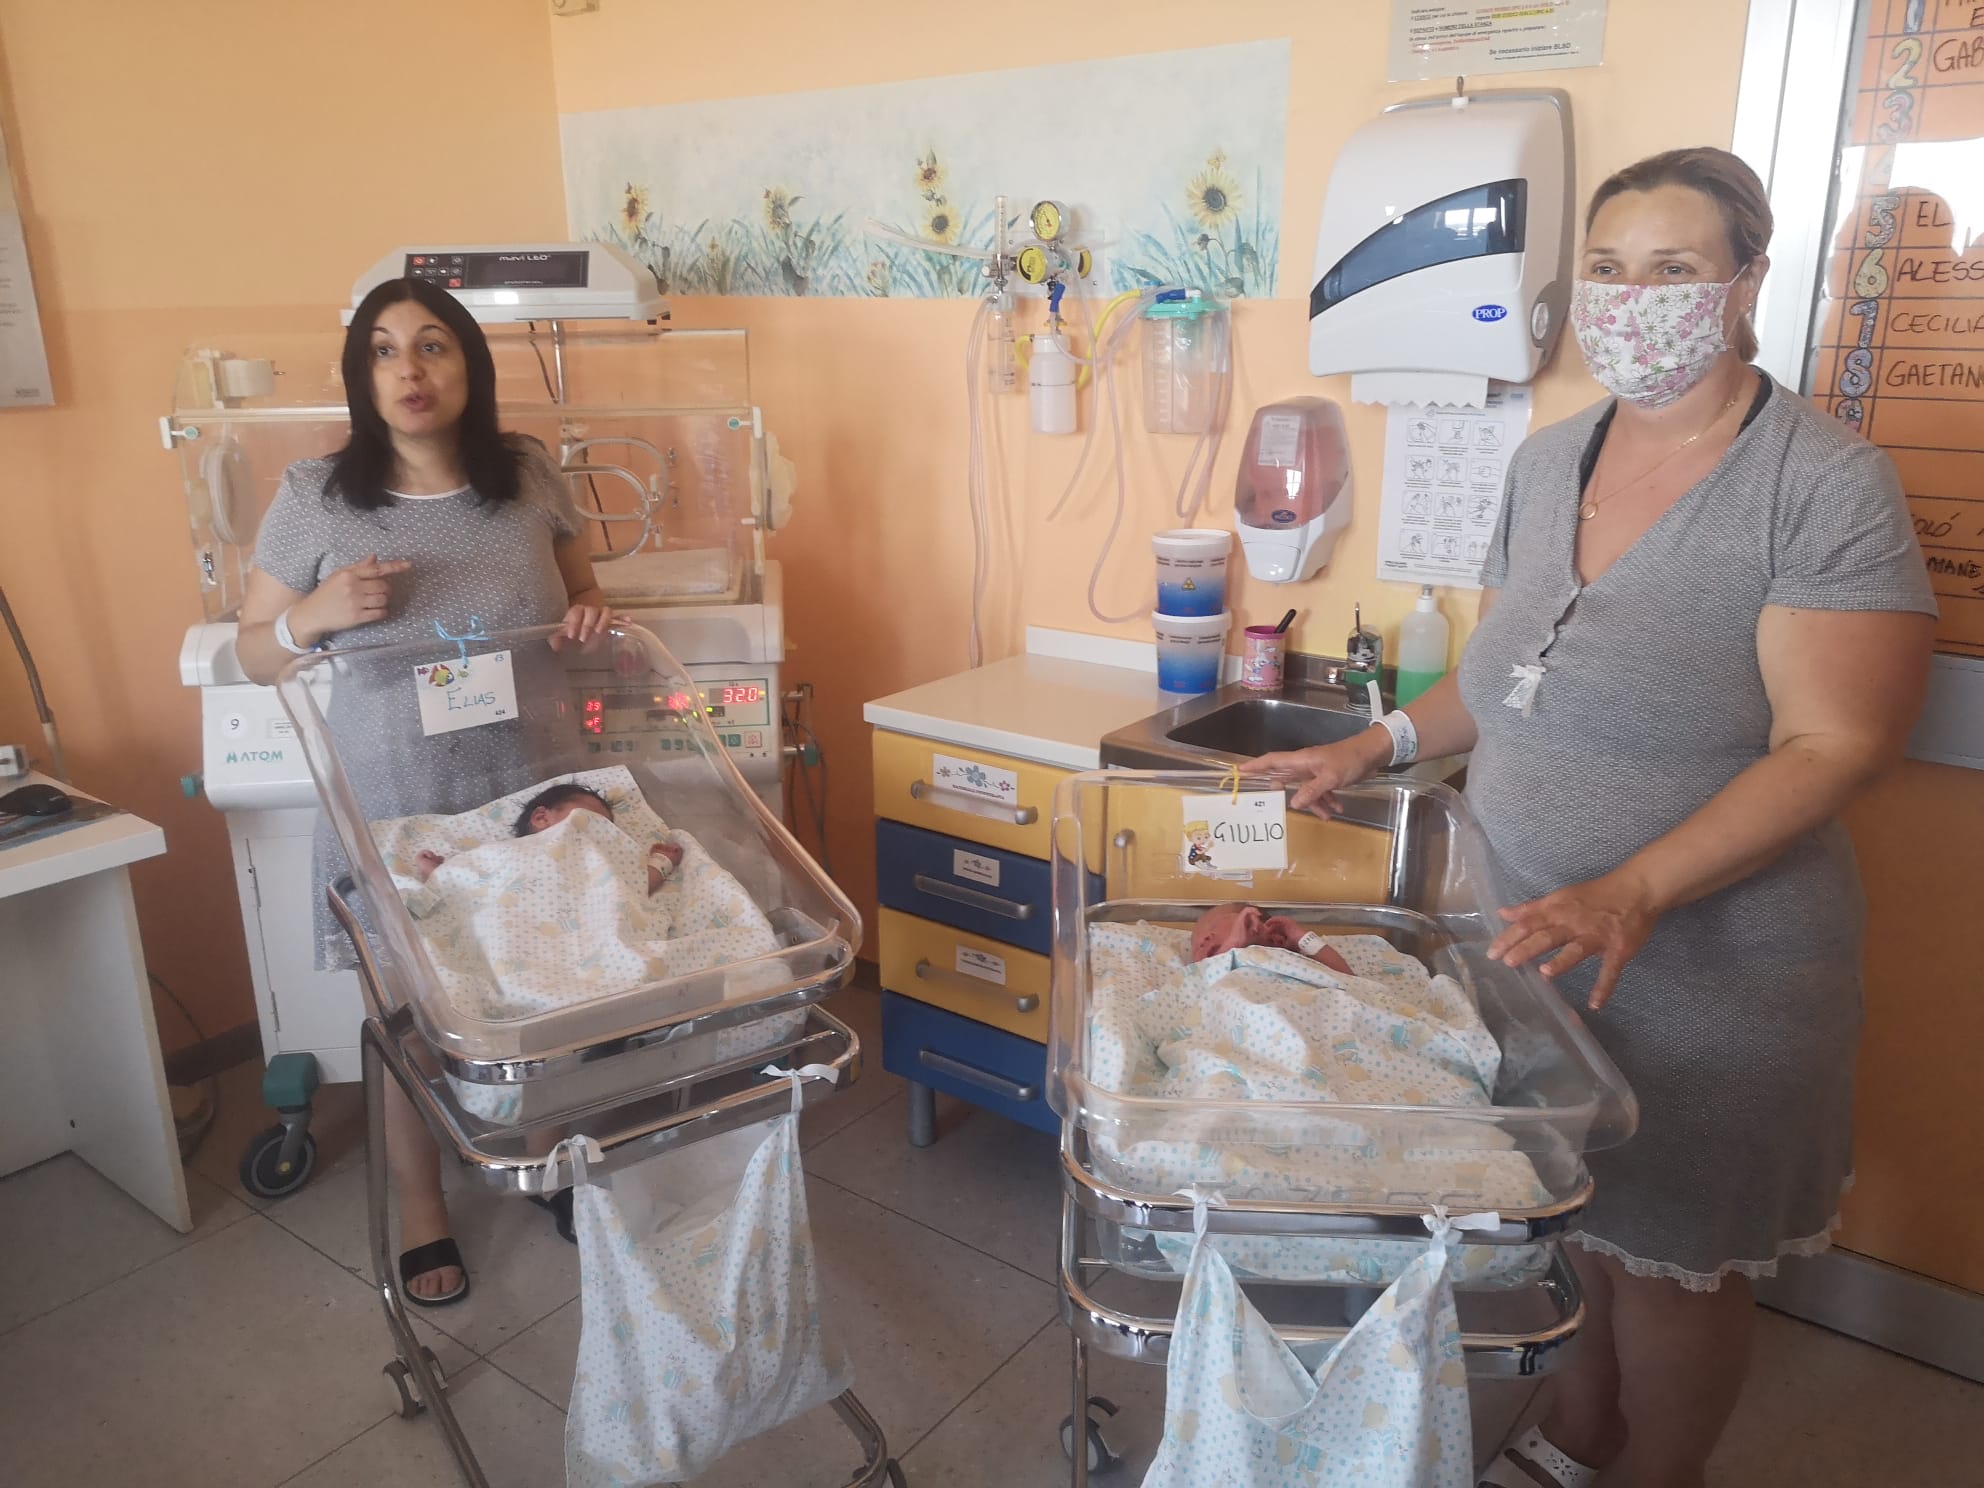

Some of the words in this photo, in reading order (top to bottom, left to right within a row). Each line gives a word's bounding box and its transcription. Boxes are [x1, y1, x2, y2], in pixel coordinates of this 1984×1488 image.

[1865, 195, 1900, 248] 5
[1853, 248, 1888, 299] 6
[1475, 307, 1506, 319] PROP
[1840, 349, 1873, 397] 8
[446, 687, 496, 711] ELIAS
[240, 750, 284, 762] ATOM
[1214, 821, 1284, 843] GIULIO
